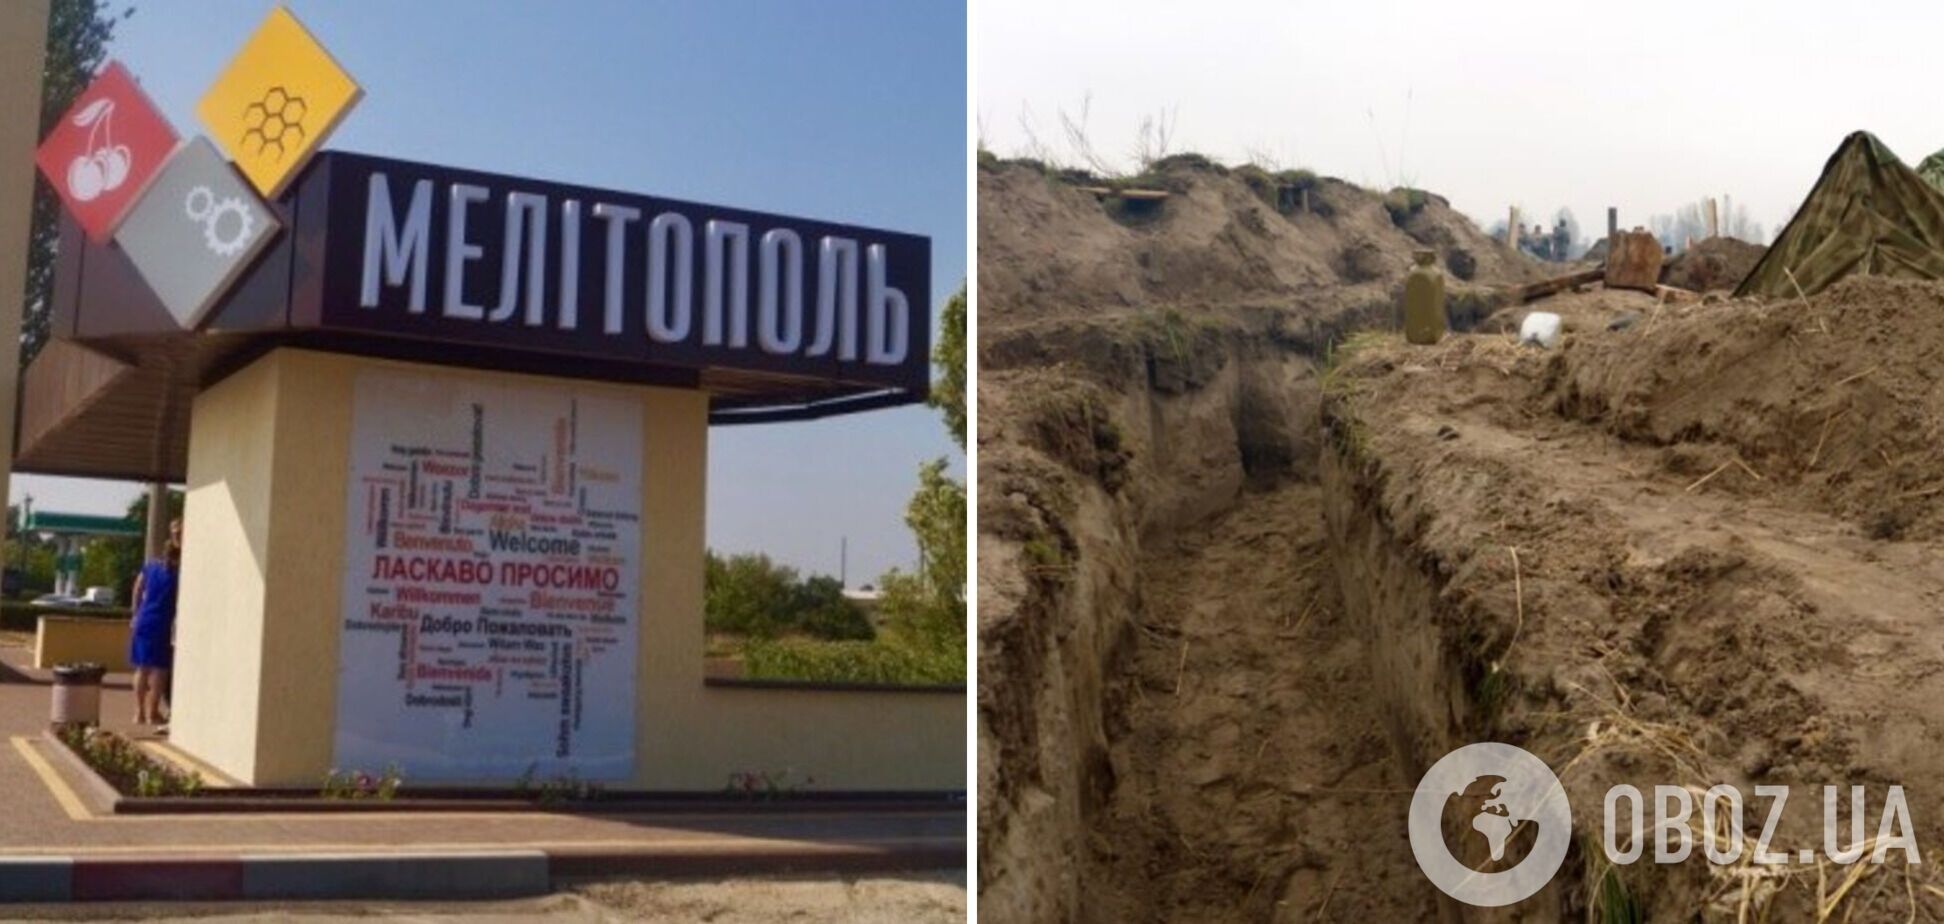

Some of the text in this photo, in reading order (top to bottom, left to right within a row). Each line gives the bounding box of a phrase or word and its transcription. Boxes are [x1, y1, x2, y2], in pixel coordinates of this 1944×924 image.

[360, 172, 909, 366] МЕЛІТОПОЛЬ
[489, 530, 581, 556] Welcome
[372, 555, 619, 590] ЛАСКАВО ПРОСИМО
[396, 587, 481, 604] Willkommen
[420, 613, 473, 635] Добро
[477, 615, 573, 637] Пожаловать
